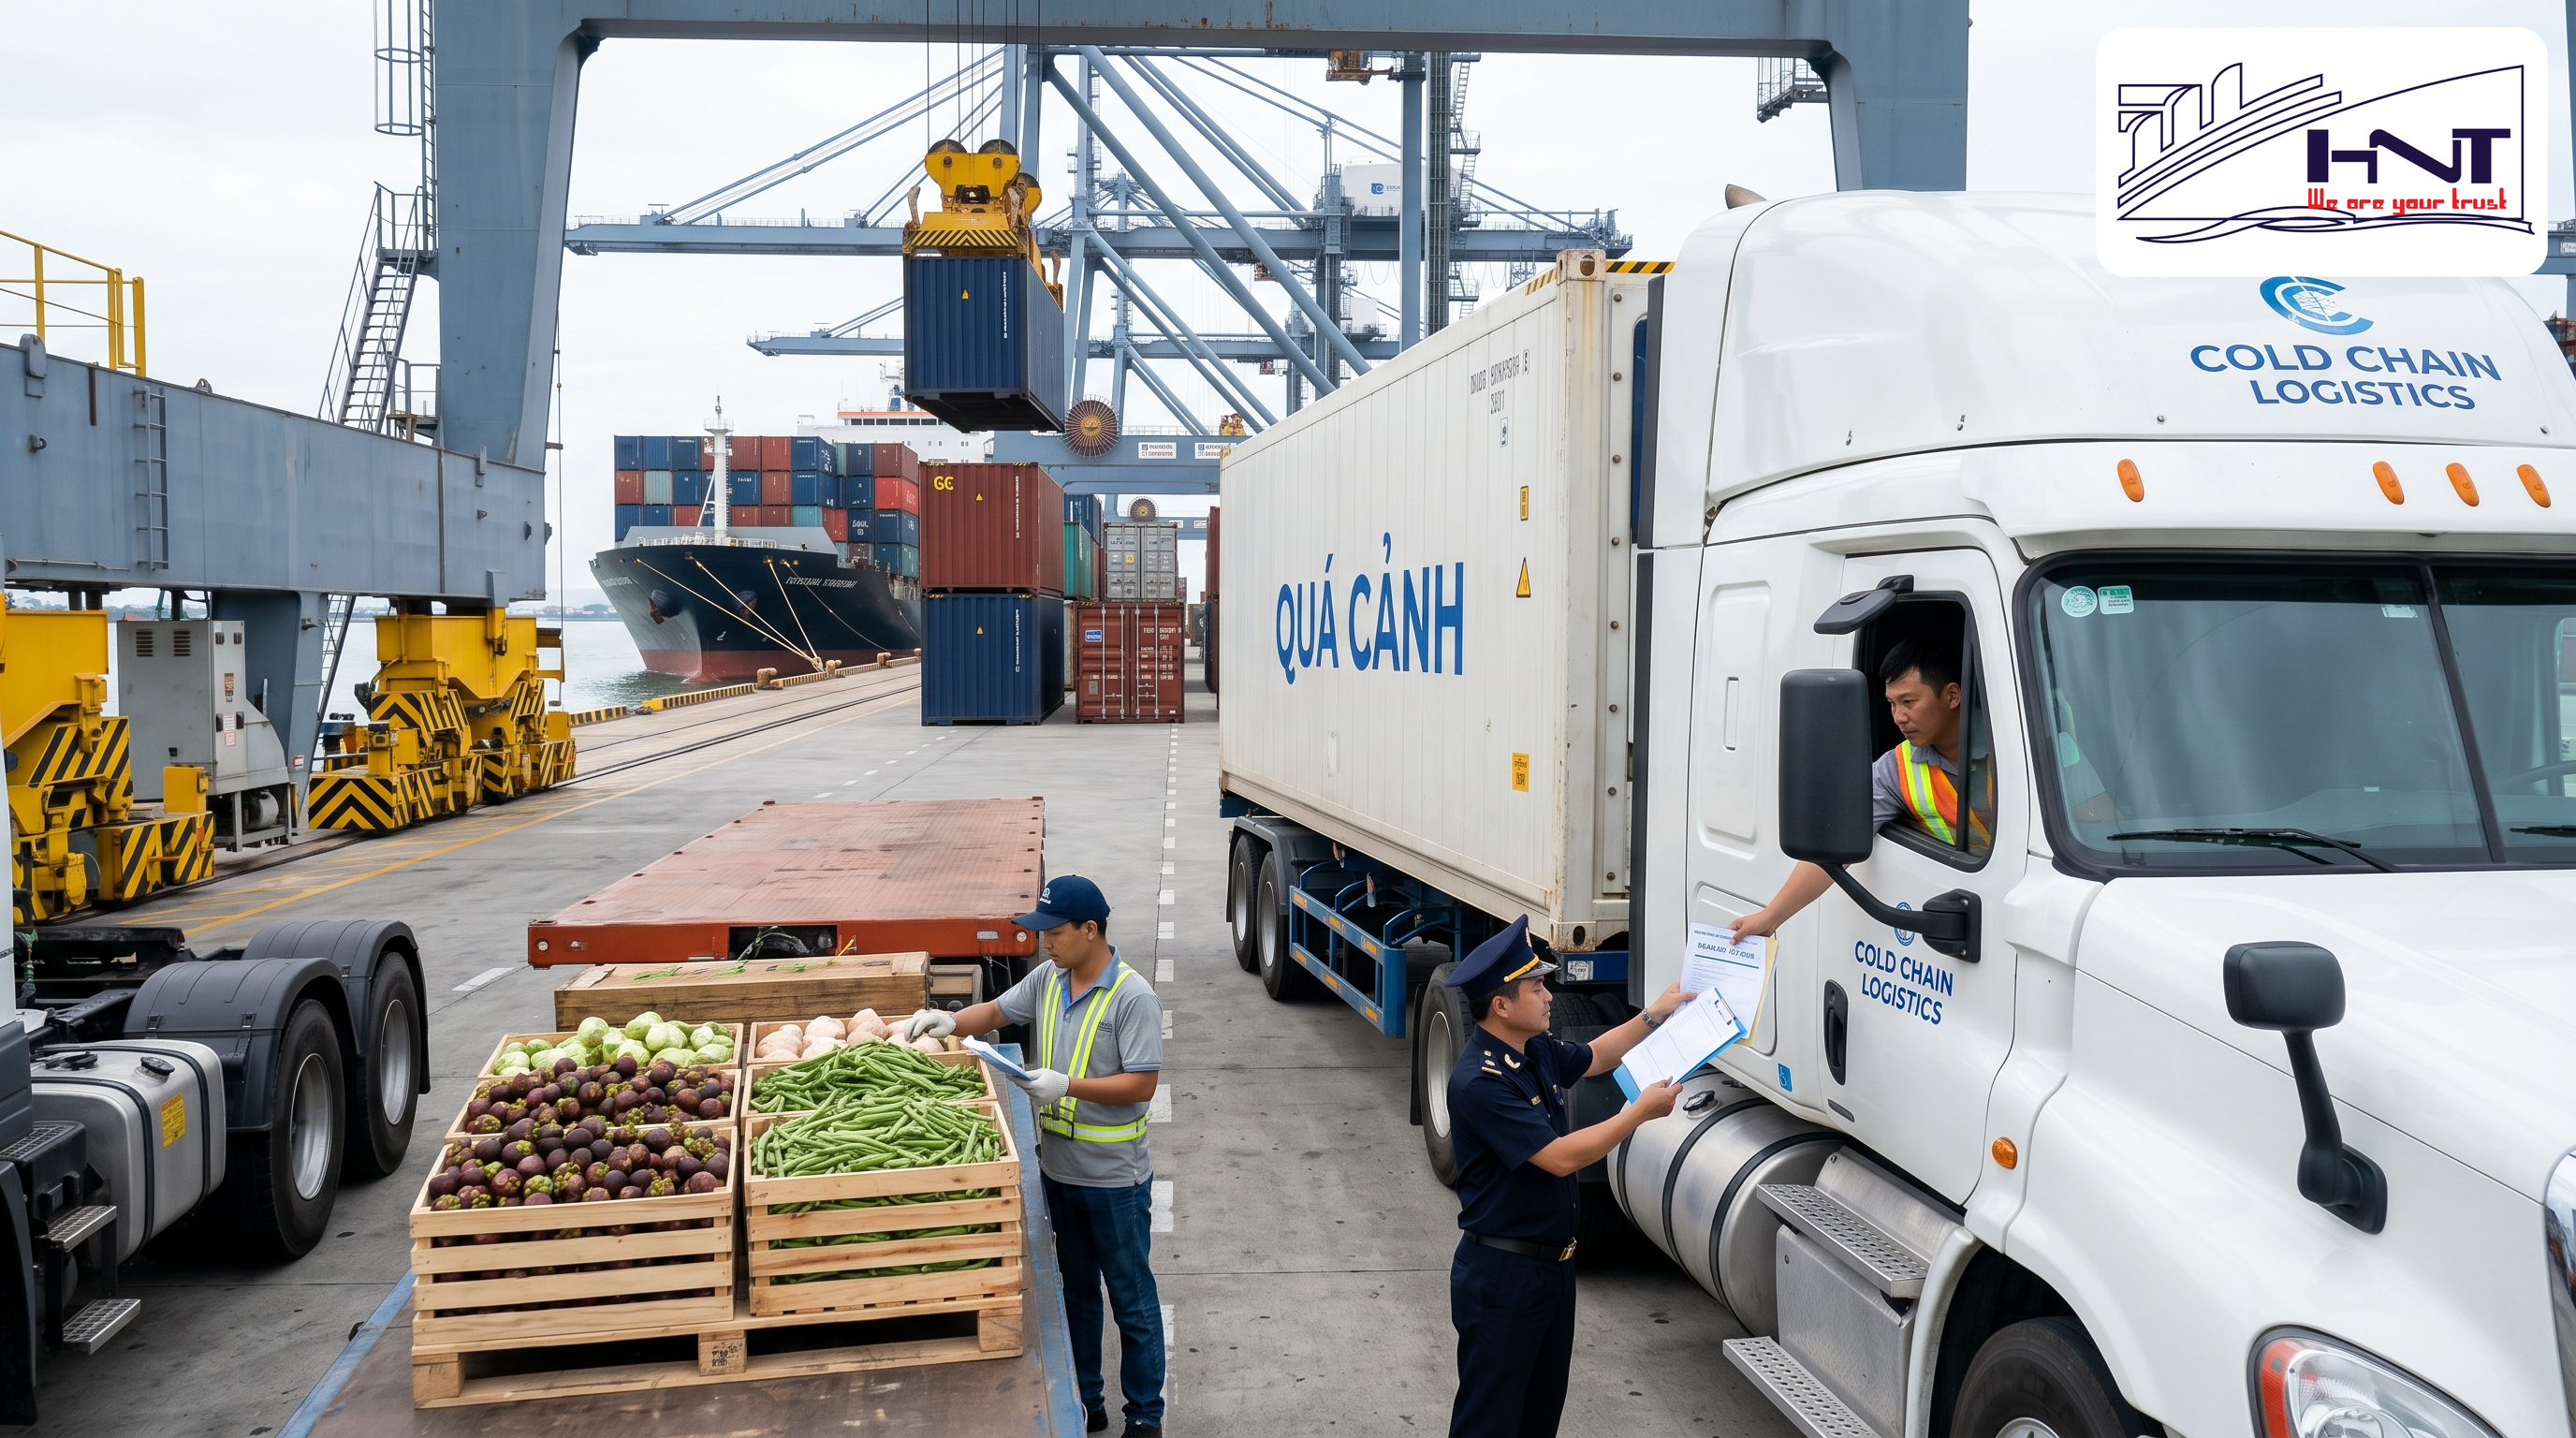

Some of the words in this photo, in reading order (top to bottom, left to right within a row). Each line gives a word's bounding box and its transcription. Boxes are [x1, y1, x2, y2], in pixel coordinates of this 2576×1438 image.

[2189, 344, 2333, 373] COLD
[2346, 345, 2502, 382] CHAIN
[2249, 379, 2476, 410] LOGISTICS
[1276, 552, 1339, 685] QUÁ
[1348, 532, 1465, 676] CẢNH
[1854, 940, 1896, 974] COLD
[1900, 956, 1954, 997] CHAIN
[1861, 973, 1943, 1025] LOGISTICS
